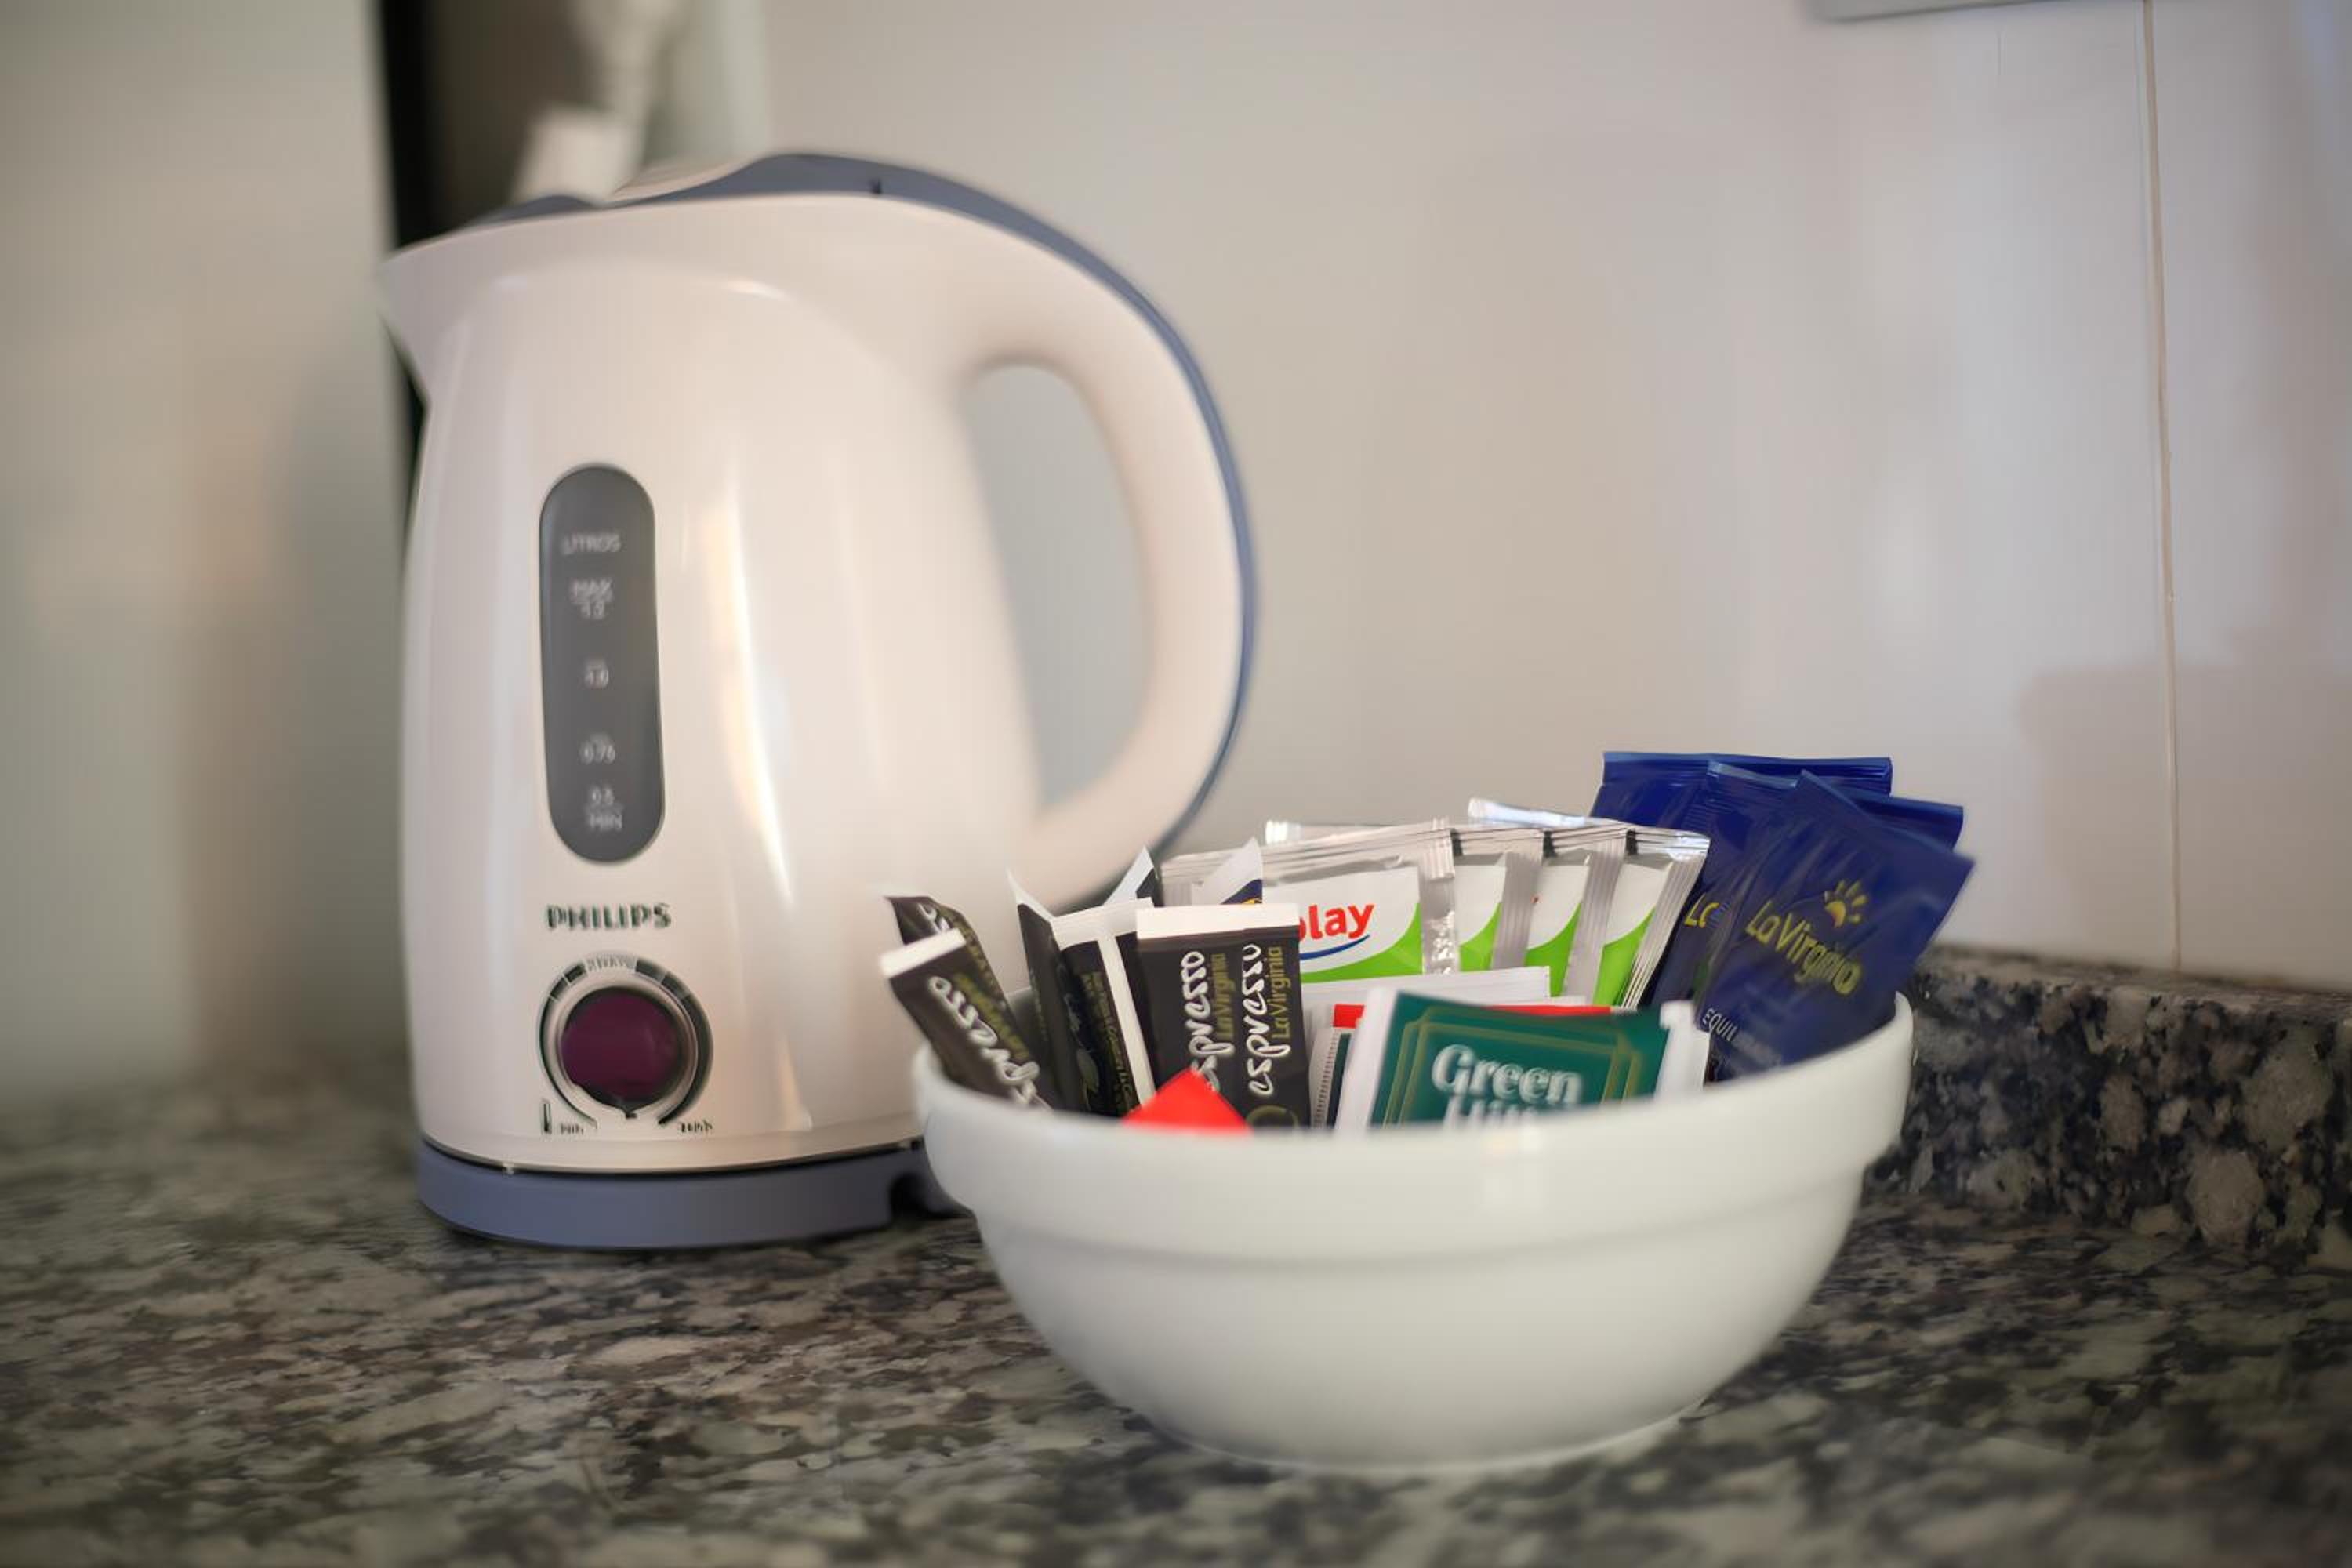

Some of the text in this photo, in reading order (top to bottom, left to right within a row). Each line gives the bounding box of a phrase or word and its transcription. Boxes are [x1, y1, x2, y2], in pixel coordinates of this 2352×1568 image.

[548, 903, 672, 928] PHILIPS
[1242, 943, 1292, 1096] espresso
[1432, 1044, 1583, 1105] Green
